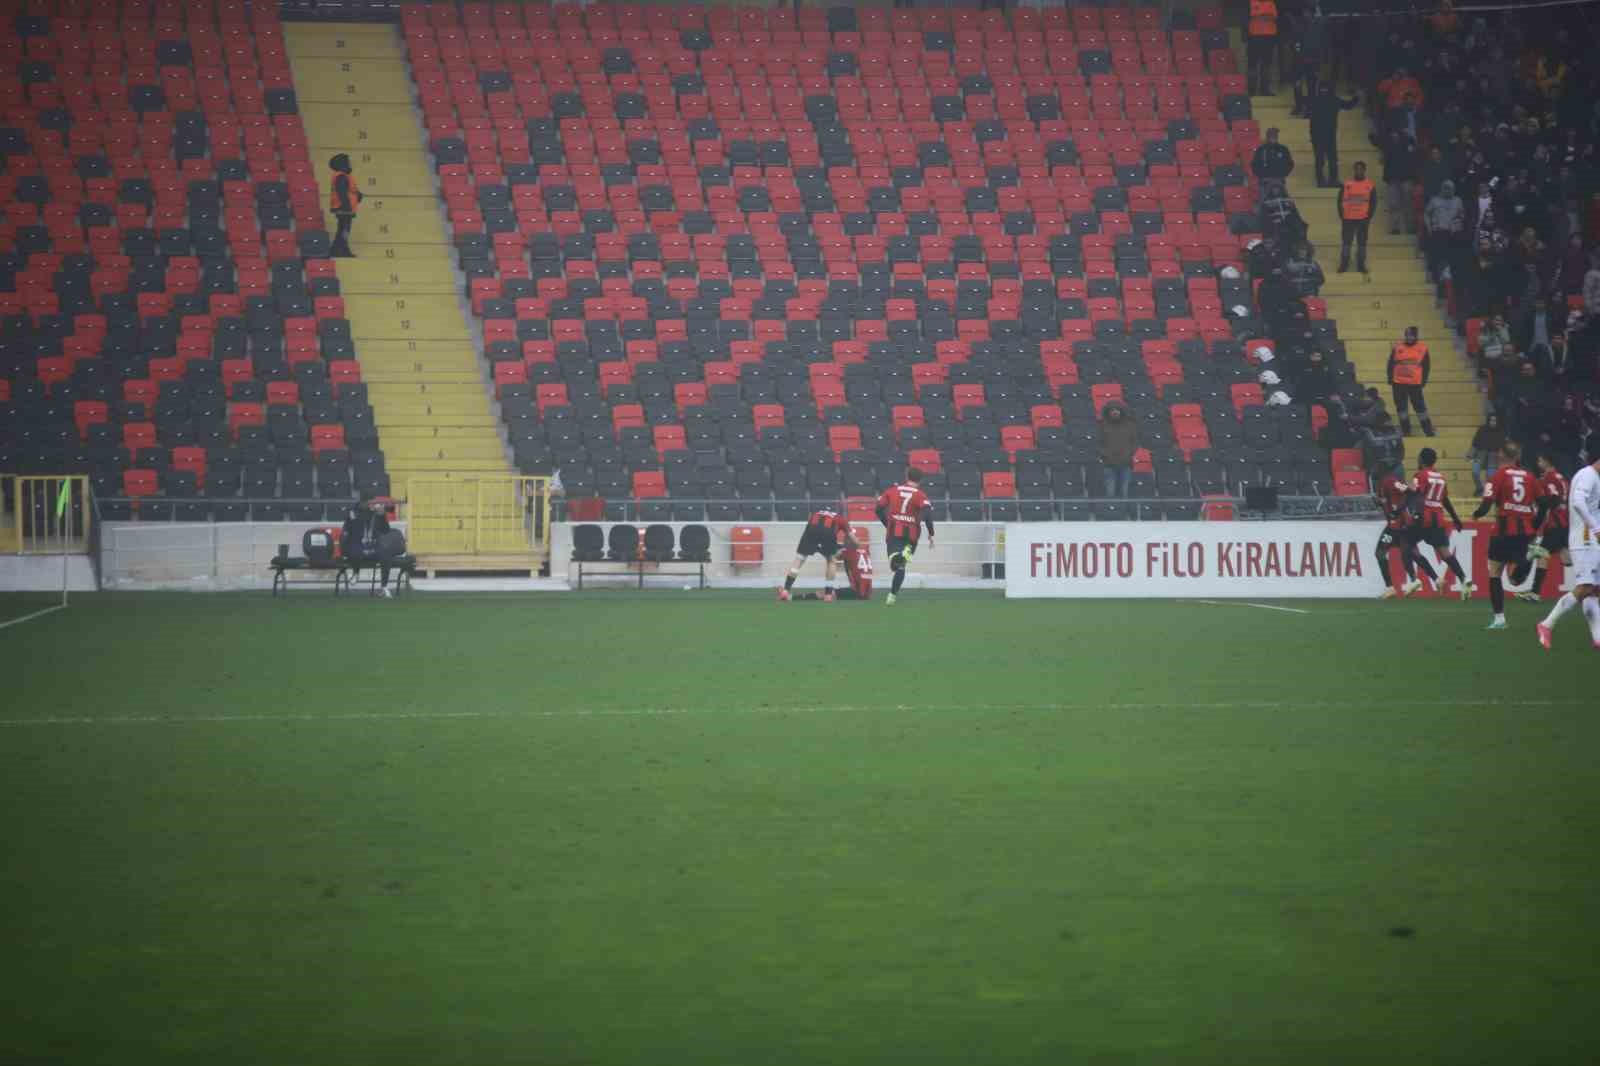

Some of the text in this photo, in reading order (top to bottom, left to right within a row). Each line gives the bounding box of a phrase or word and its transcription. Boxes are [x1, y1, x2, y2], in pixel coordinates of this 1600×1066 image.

[1427, 478, 1445, 501] 77
[1512, 476, 1526, 503] 5
[900, 492, 913, 514] 7
